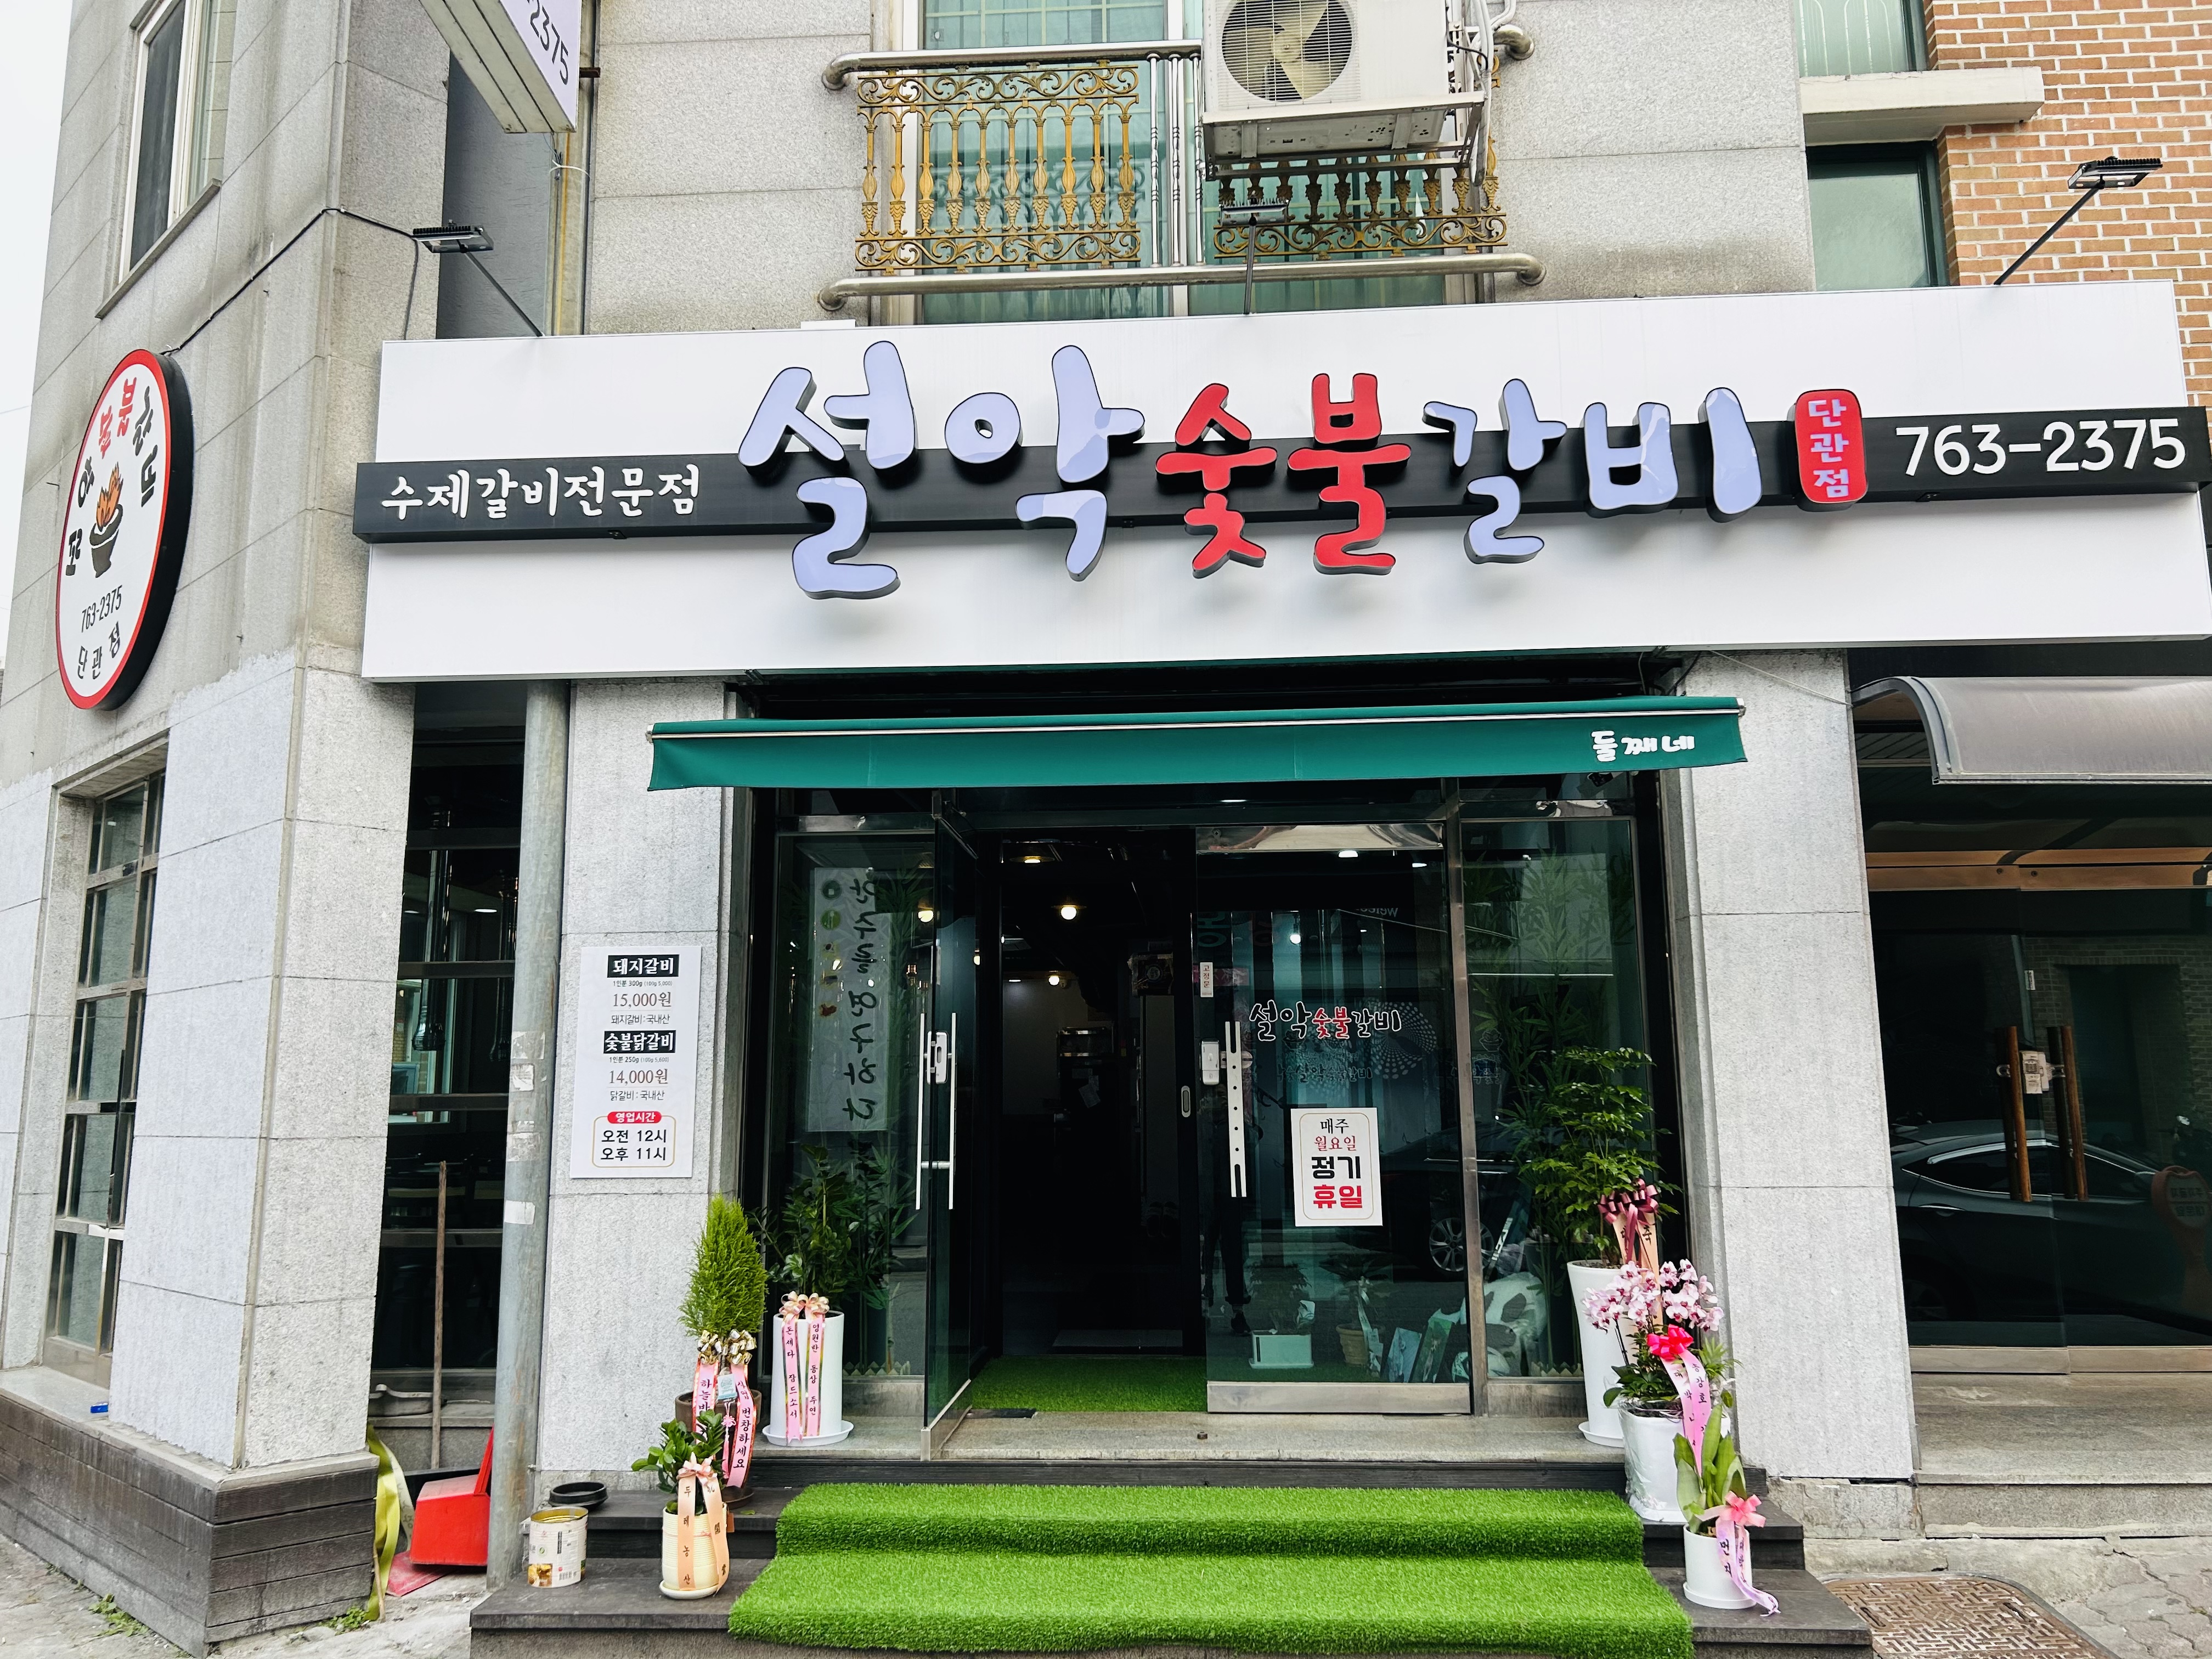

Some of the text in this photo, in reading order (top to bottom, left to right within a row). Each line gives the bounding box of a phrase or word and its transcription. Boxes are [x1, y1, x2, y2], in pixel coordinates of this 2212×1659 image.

[1808, 398, 1849, 498] 단관점
[1895, 417, 2186, 477] 763-2375
[738, 340, 1763, 599] 설악숯불갈비
[381, 464, 701, 521] 수제갈비전문점
[81, 585, 123, 633] 763-2375
[1591, 730, 1695, 762] 둘째네
[613, 957, 674, 975] 돼지갈비
[613, 992, 672, 1008] 15,000원
[1249, 999, 1402, 1042] 설악숯불갈비
[605, 1032, 674, 1052] 숯불닭갈비
[609, 1068, 668, 1086] 14,000원
[615, 1111, 656, 1124] 영업시간
[1320, 1119, 1350, 1134] 매주
[601, 1129, 667, 1143] 오전 12시
[1314, 1136, 1357, 1151] 월요일
[600, 1147, 667, 1161] 오후 11시
[1311, 1155, 1361, 1180] 정기
[1313, 1184, 1363, 1209] 휴일
[786, 1325, 795, 1359] 돈세다
[811, 1323, 820, 1353] 영원한
[733, 1380, 752, 1469] 사업 번창하세요
